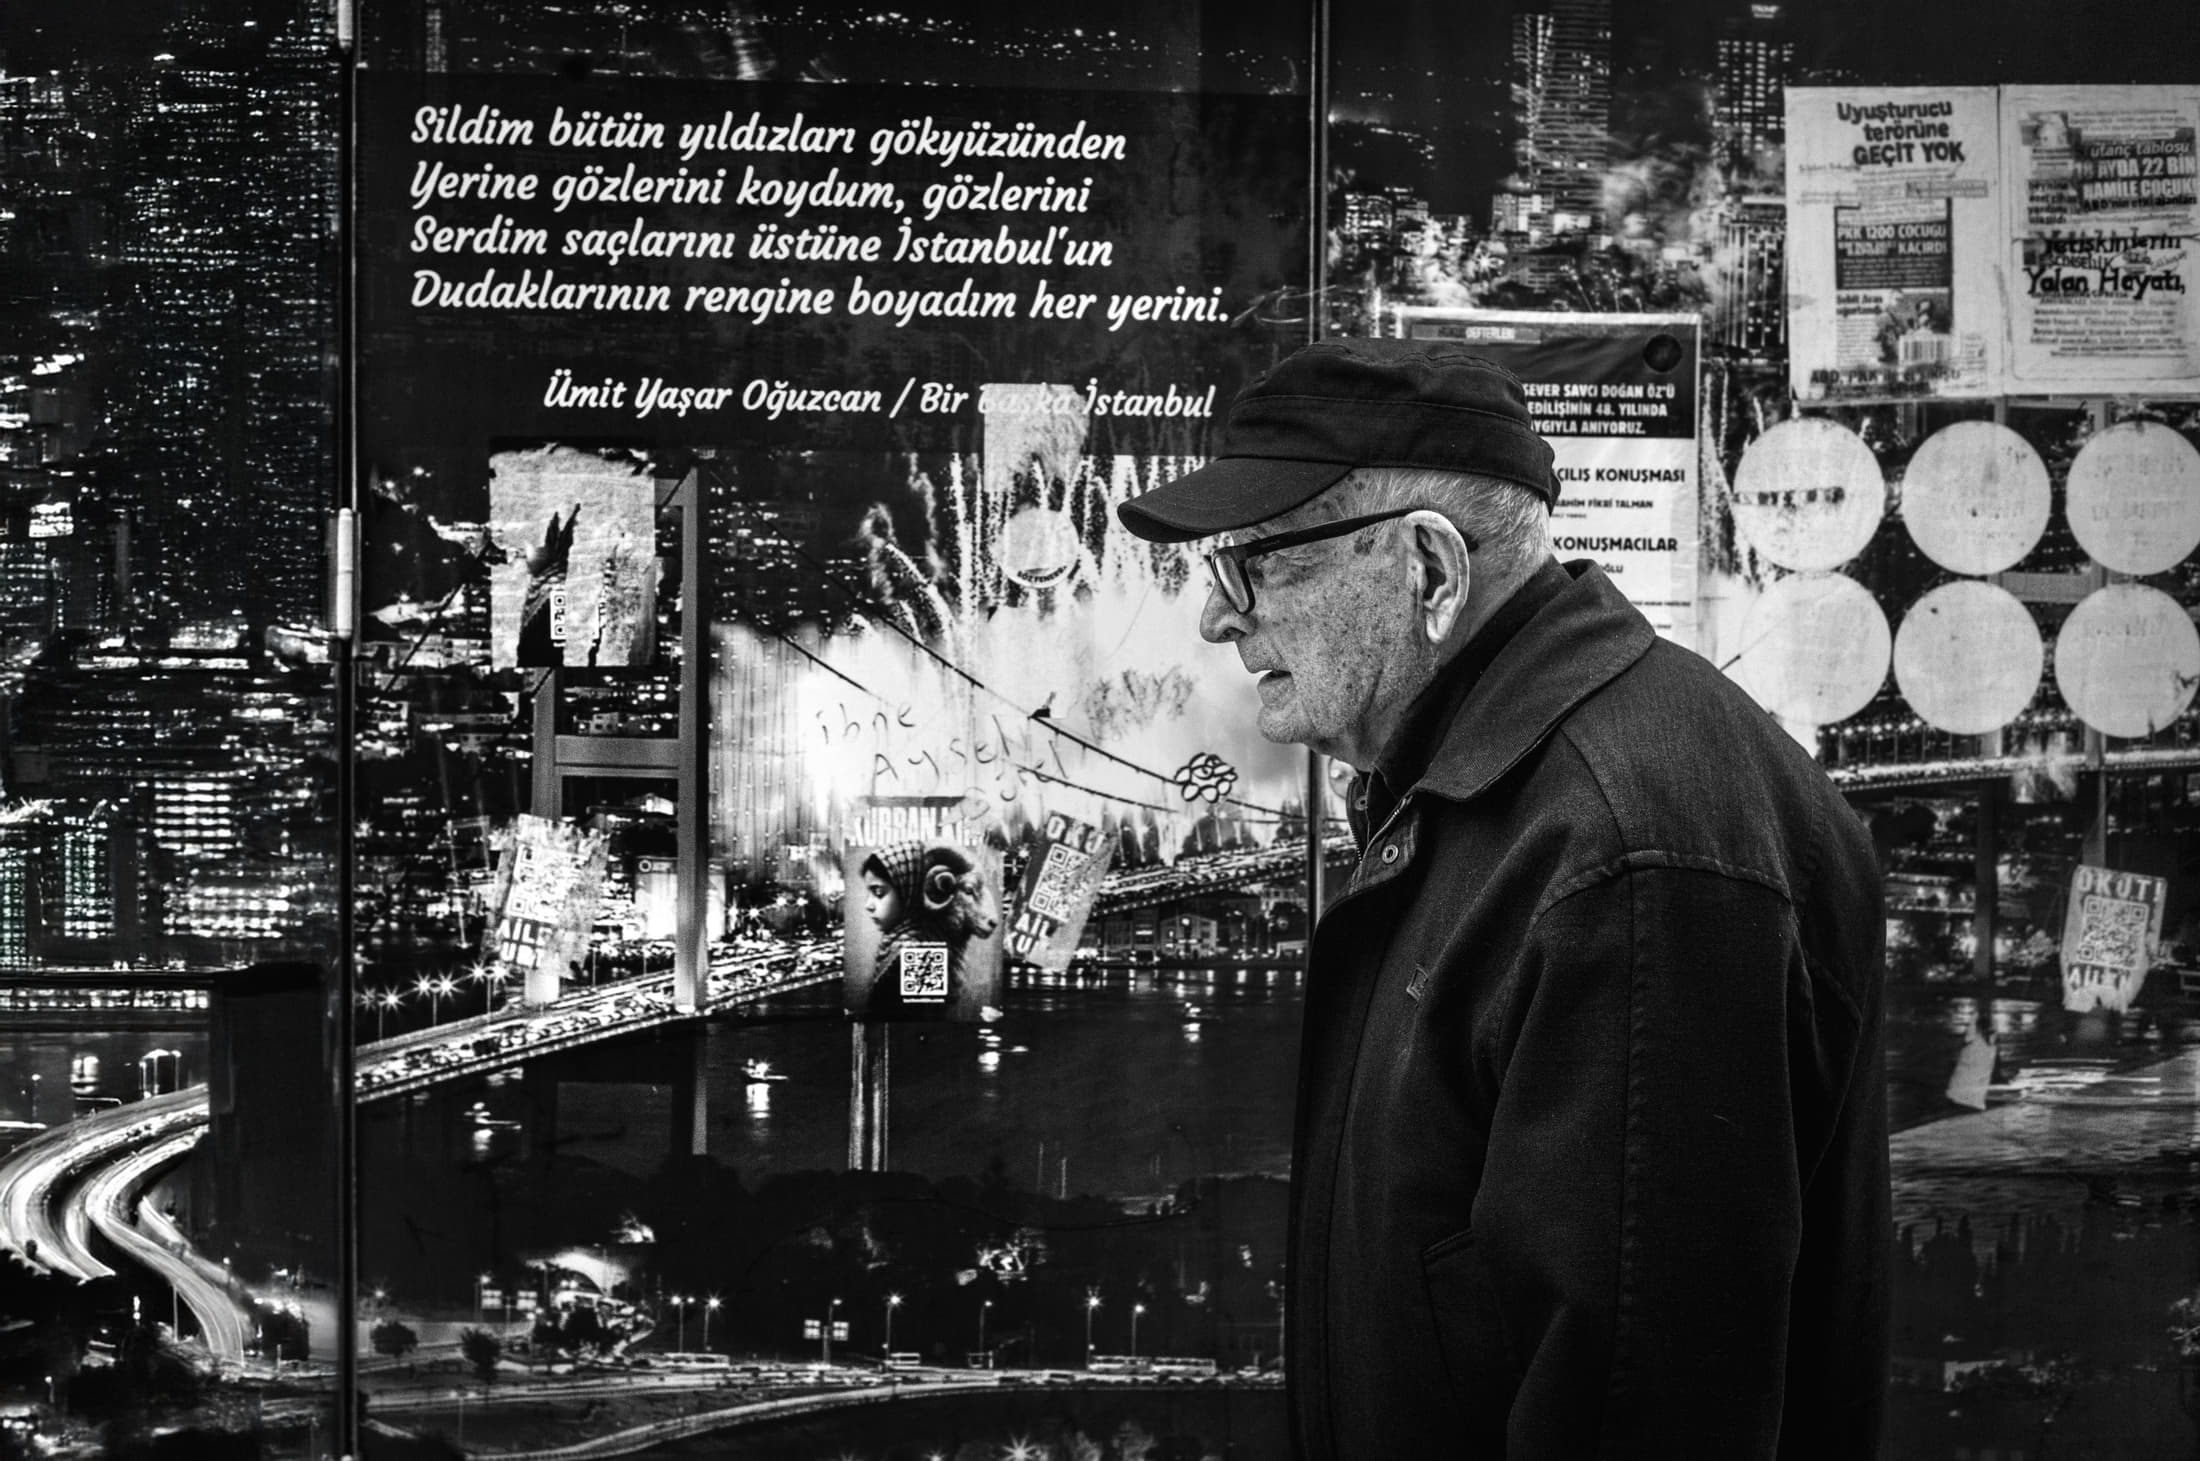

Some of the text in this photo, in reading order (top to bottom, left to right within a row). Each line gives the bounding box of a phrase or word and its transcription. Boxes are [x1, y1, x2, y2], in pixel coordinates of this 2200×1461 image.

[1837, 101, 1953, 124] Uyuşturucu
[411, 104, 1126, 167] Sildim bütün yıldızları gökyüzünden
[1862, 120, 1950, 141] terörüne
[1853, 141, 1915, 168] GEÇİT
[1921, 141, 1965, 162] YOK
[2142, 157, 2164, 176] 22
[2166, 153, 2197, 175] BİN
[411, 161, 1093, 221] Yerine gözlerini koydum, gözlerini
[411, 214, 1113, 266] Serdim saçlarını üstüne İstanbul'un
[1866, 225, 1895, 239] 1200
[2022, 267, 2089, 294] Yalan
[412, 268, 1228, 332] Dudaklarının rengine boyadım her yerini.
[544, 369, 627, 408] Ümit
[635, 378, 733, 418] Yaşar
[743, 379, 881, 420] Oğuzcan
[889, 377, 916, 418] /
[920, 382, 969, 413] Bir
[1083, 378, 1216, 417] İstanbul
[1563, 383, 1598, 397] SAVCI
[1601, 384, 1643, 398] DOĞAN
[1595, 403, 1615, 416] 48.
[1618, 404, 1668, 417] YILINDA
[1580, 421, 1647, 435] ANIYORUZ.
[1595, 468, 1685, 483] KONUŞMASI
[1553, 536, 1678, 552] KONUŞMACILAR
